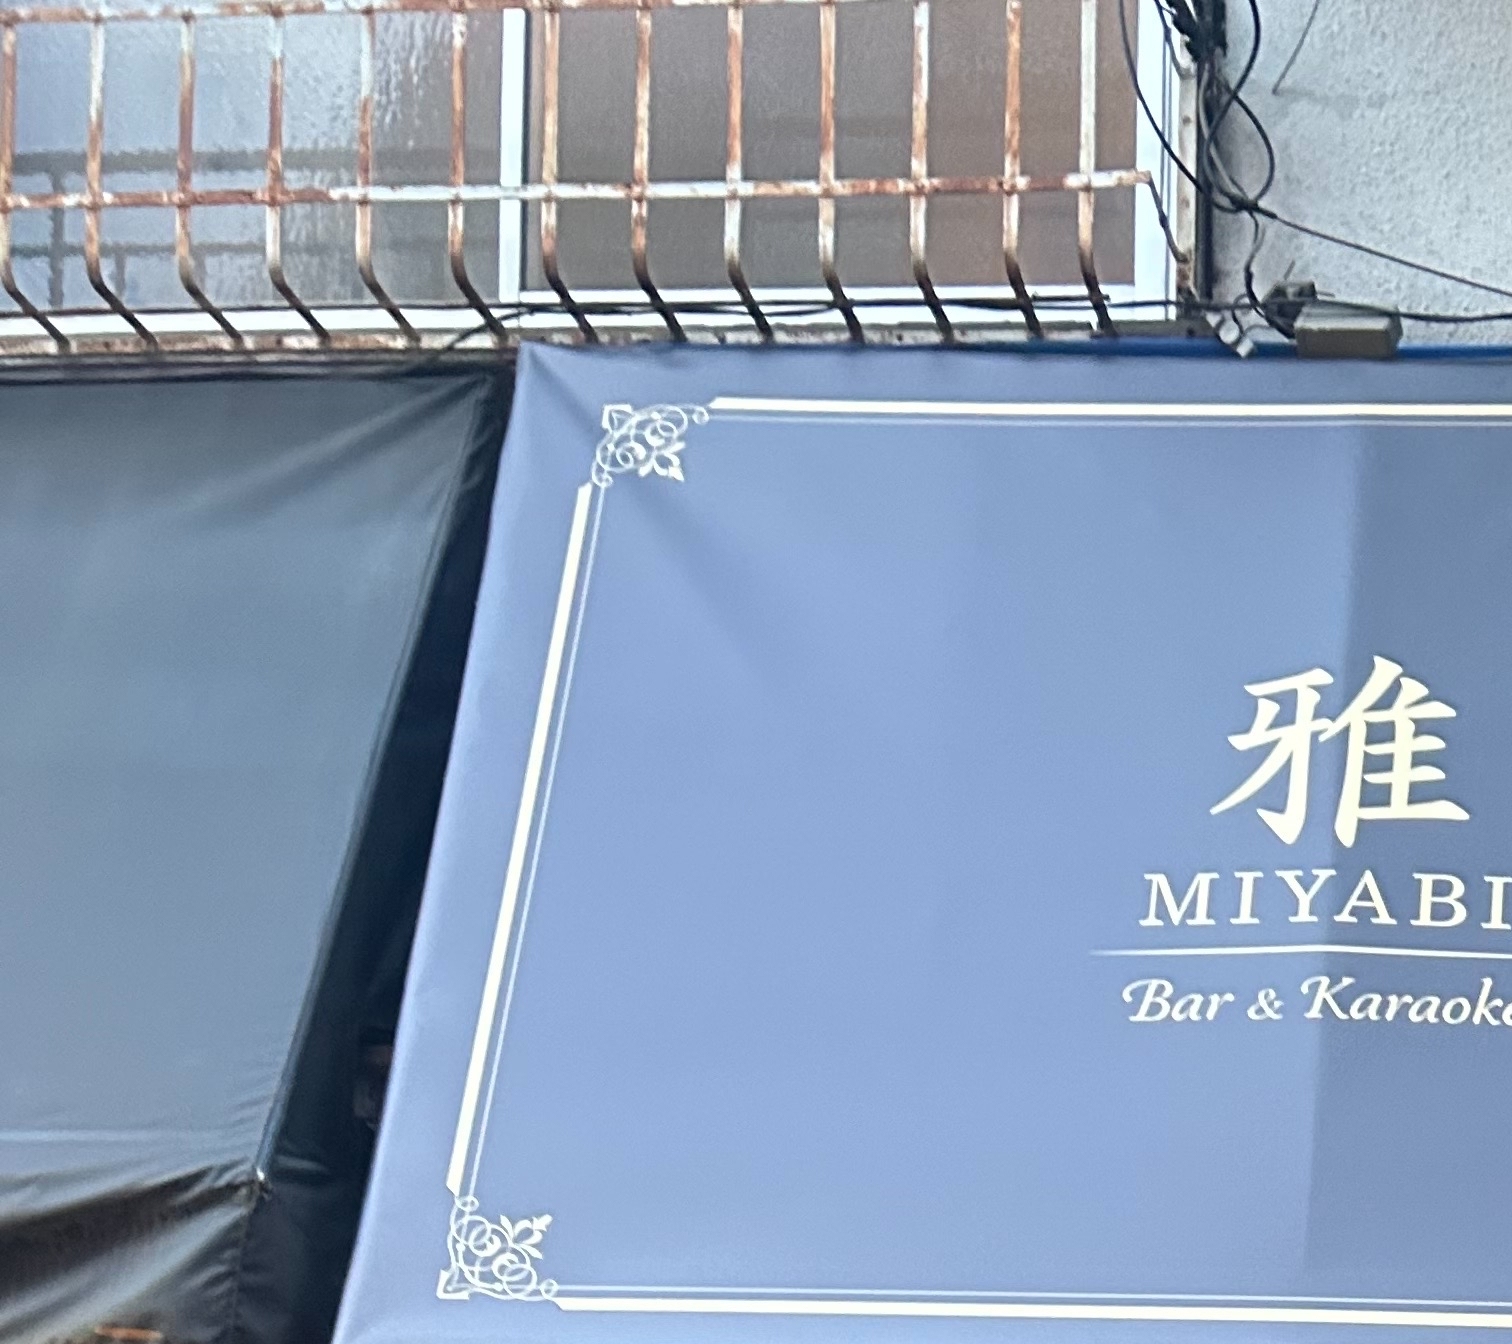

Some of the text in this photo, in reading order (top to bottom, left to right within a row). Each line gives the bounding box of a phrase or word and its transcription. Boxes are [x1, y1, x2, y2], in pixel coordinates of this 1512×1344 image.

[1209, 653, 1471, 848] 雅
[1121, 977, 1235, 1023] Bar
[1246, 987, 1285, 1021] &
